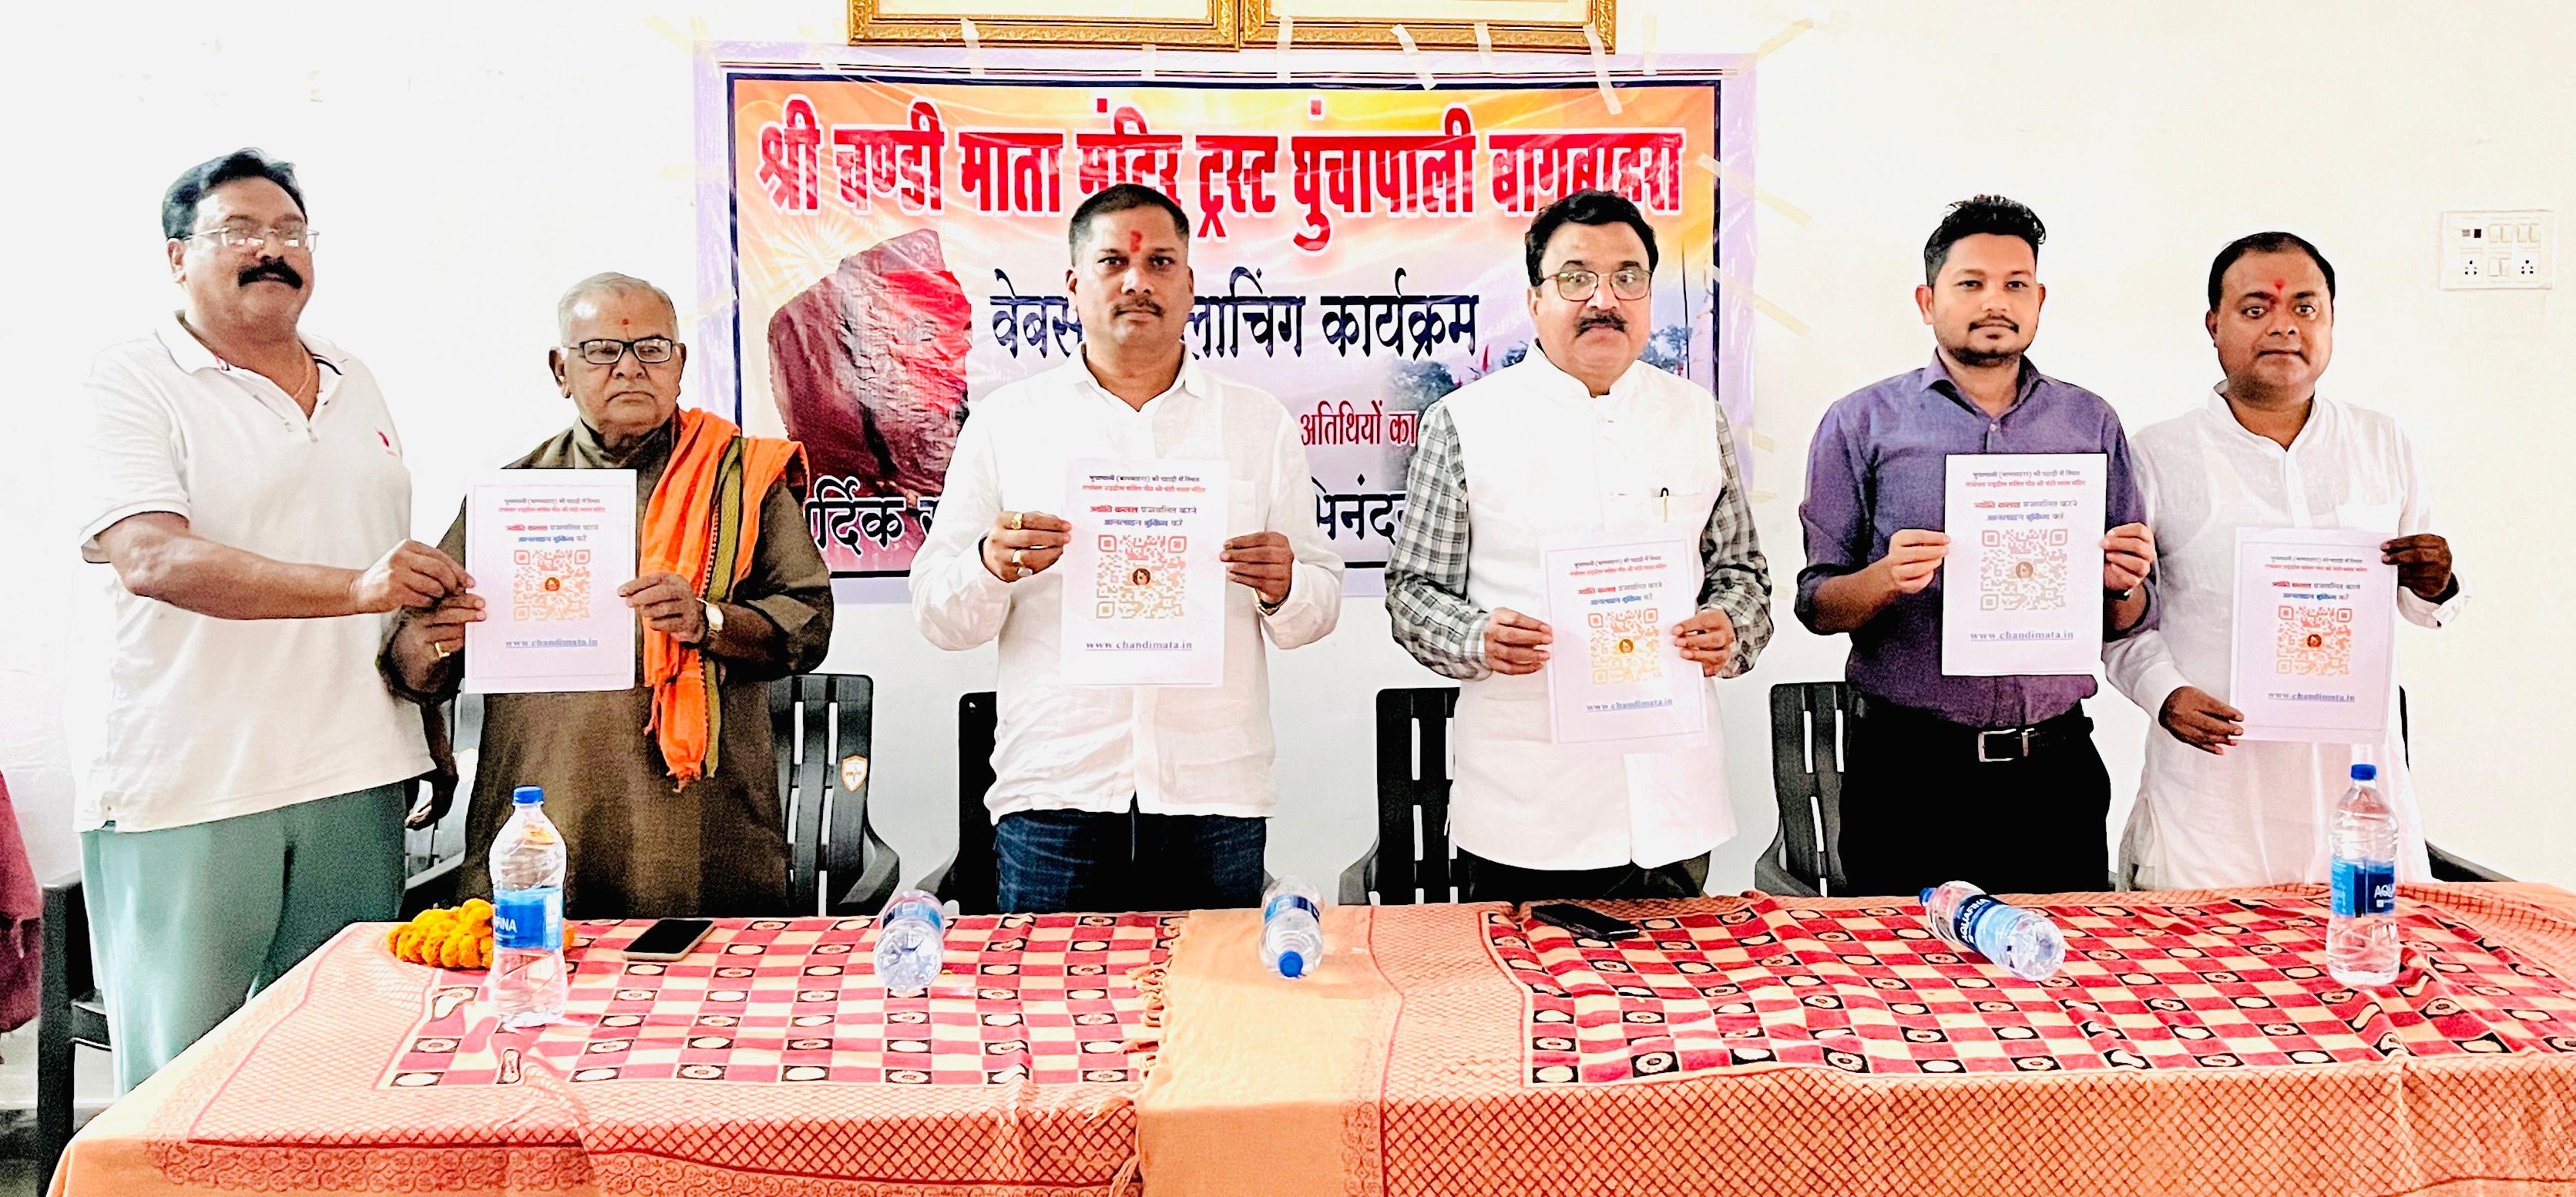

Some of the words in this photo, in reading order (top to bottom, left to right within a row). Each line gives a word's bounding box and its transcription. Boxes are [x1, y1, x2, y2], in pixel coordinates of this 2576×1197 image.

[758, 99, 820, 210] श्री
[833, 102, 944, 211] चण्डी
[959, 132, 1063, 212] माता
[1076, 98, 1183, 206] मंदिर
[1196, 134, 1278, 237] ट्रस्ट
[1489, 132, 1684, 213] बागबाहरा
[1320, 267, 1479, 360] कार्यक्रम
[1300, 400, 1383, 446] अतिथियों
[1389, 413, 1418, 445] का
[1086, 640, 1193, 651] www.chandimata.in
[1970, 630, 2074, 642] www.chandimata.in
